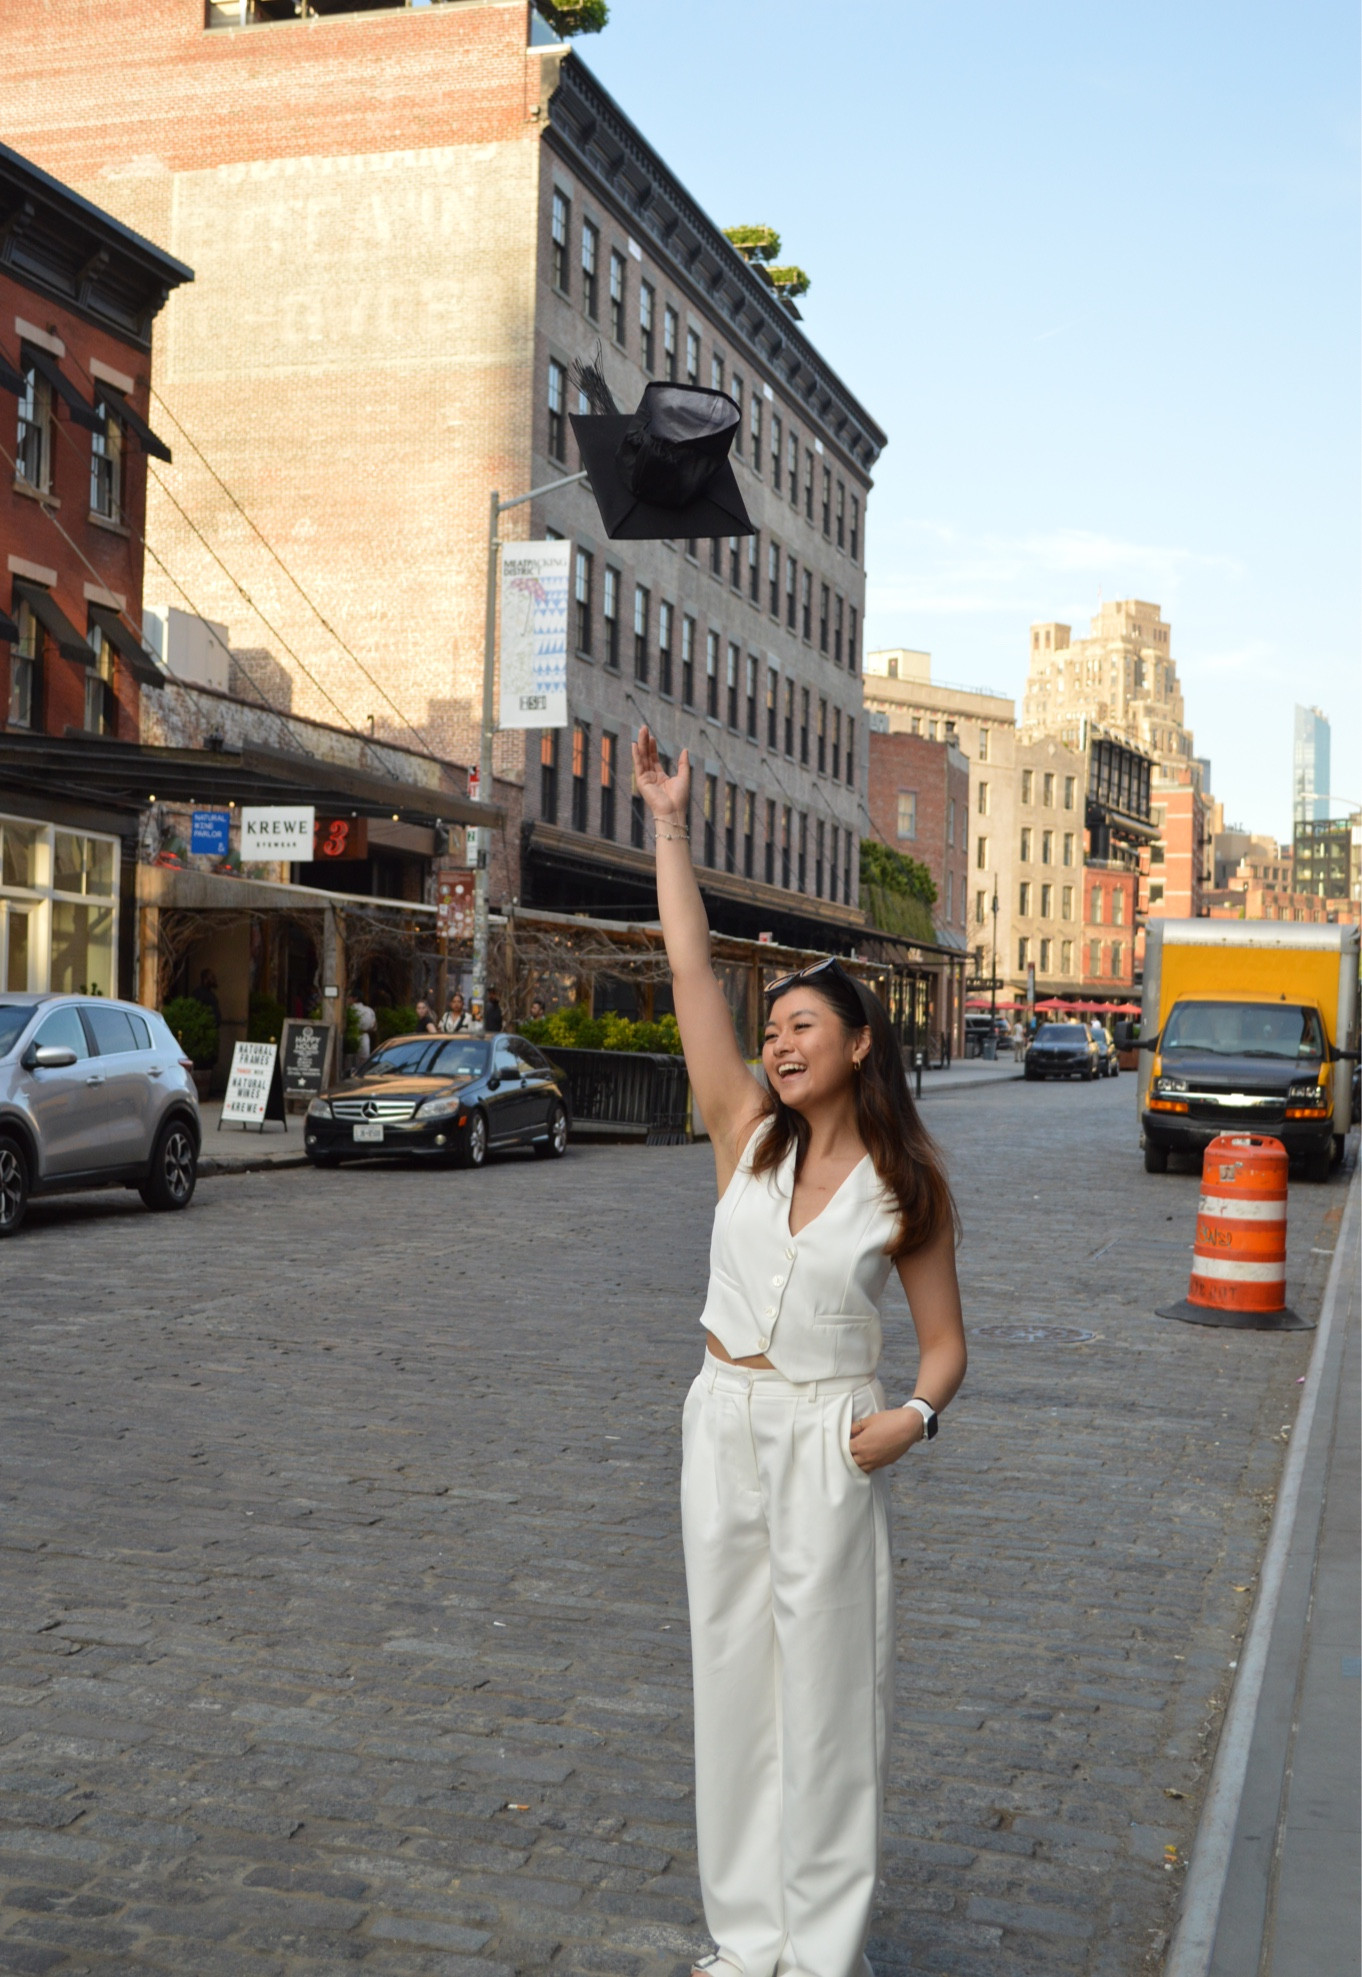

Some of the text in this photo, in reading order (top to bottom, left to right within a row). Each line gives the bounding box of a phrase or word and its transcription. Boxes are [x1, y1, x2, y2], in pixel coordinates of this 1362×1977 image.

[503, 558, 567, 568] MEATPACKING
[503, 568, 542, 576] DISTRICT
[194, 814, 227, 823] NATURAL
[247, 821, 308, 834] KREWE
[193, 830, 222, 838] PARLOR
[295, 1036, 321, 1044] HAPPY
[239, 1044, 272, 1056] NATURAL
[239, 1053, 270, 1065] FRAMES
[232, 1077, 266, 1090] NATURAL
[237, 1088, 260, 1099] WINES
[231, 1101, 258, 1113] KREWE
